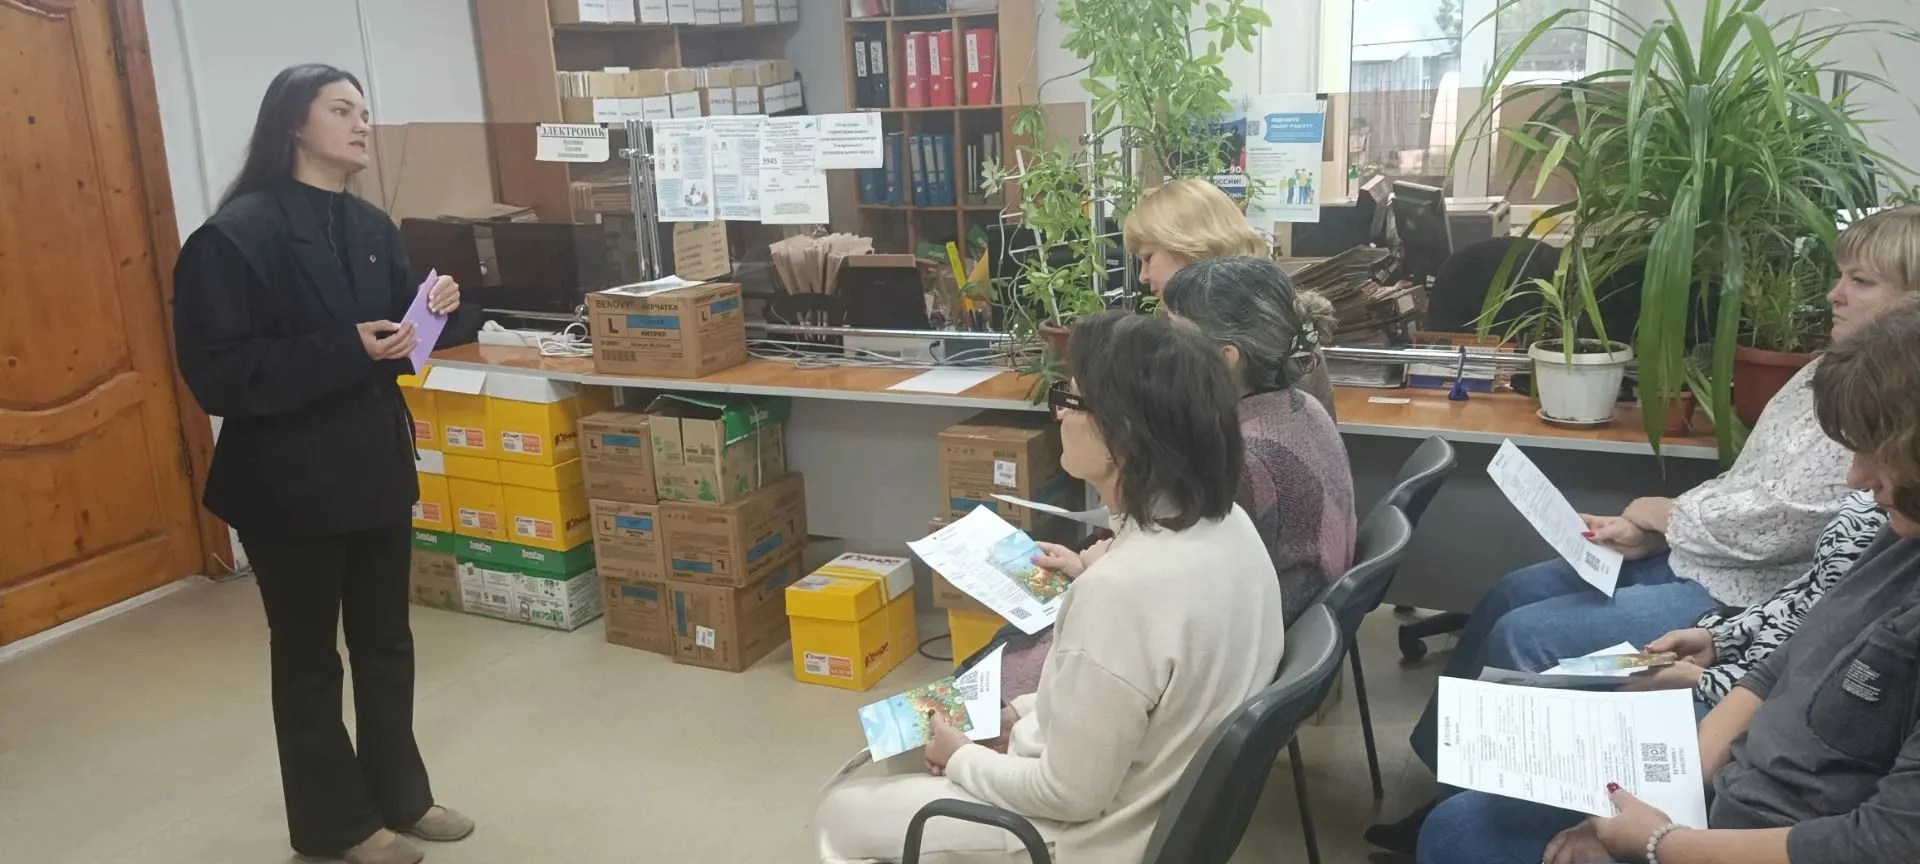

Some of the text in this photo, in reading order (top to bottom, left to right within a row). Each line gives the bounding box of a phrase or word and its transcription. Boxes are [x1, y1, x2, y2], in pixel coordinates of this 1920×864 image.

[608, 317, 619, 334] L
[590, 437, 598, 450] L
[604, 520, 611, 531] L
